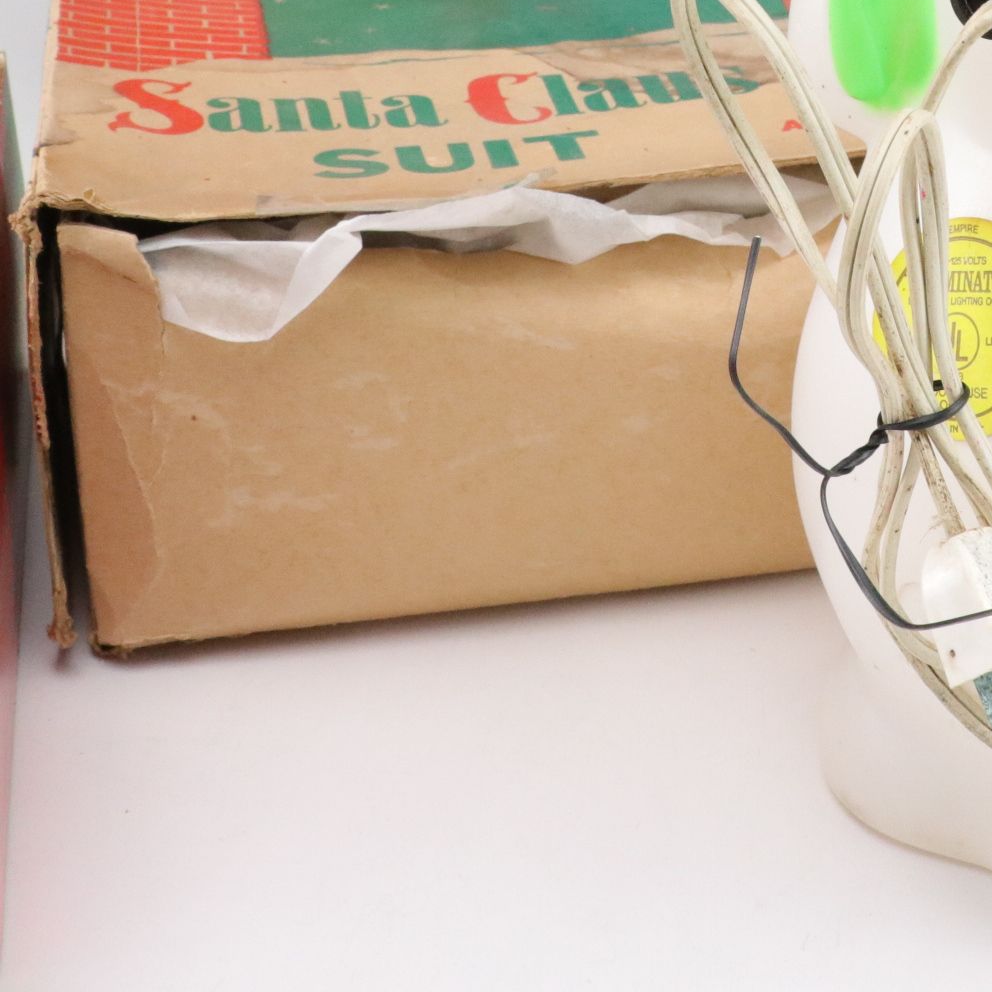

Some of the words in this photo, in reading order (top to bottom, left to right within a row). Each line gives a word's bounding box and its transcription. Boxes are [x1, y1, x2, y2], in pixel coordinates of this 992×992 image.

[107, 78, 449, 135] Santa
[312, 130, 599, 178] SUIT
[949, 223, 979, 234] EMPIRE
[963, 256, 987, 265] VOLTS
[950, 296, 983, 306] LIGHTING
